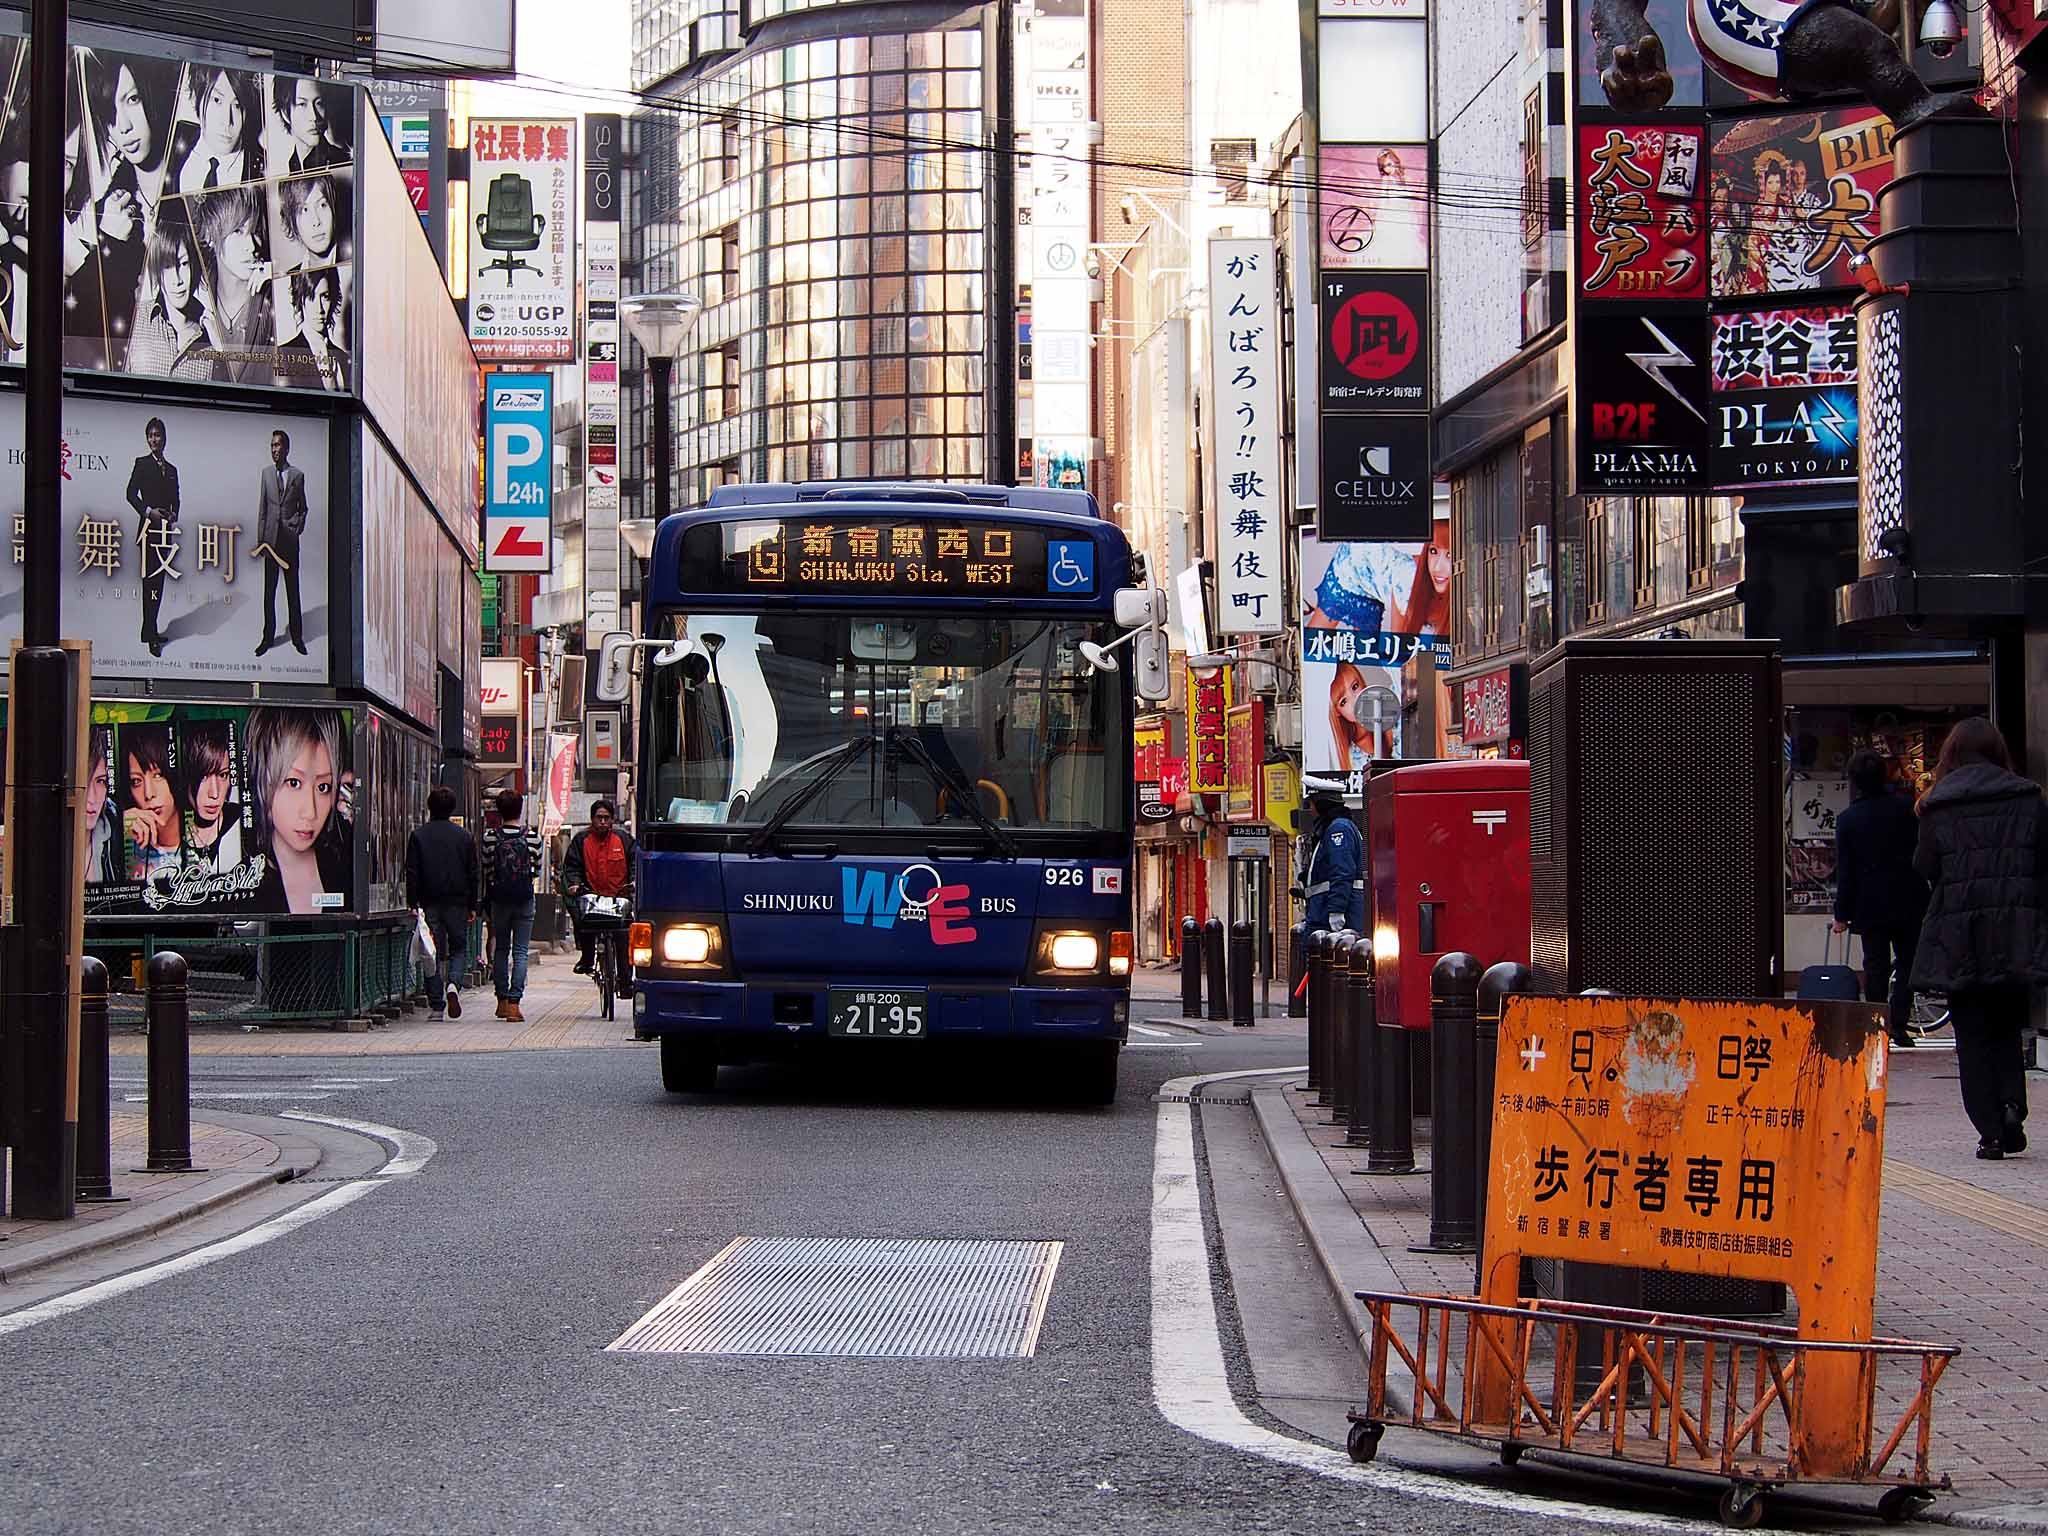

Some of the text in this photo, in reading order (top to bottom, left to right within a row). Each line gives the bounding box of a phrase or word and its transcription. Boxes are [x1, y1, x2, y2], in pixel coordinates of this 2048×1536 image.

[475, 125, 568, 161] 社長募集
[1664, 137, 1694, 191] 和風
[1583, 131, 1652, 291] 大江戸
[1328, 284, 1344, 297] 1F
[1617, 271, 1664, 291] B1F
[518, 306, 565, 321] UGP
[489, 326, 568, 336] 0120-5055-92
[472, 342, 569, 355] www.ugp.co.jp
[1717, 321, 1812, 380] 渋谷
[1329, 386, 1422, 398] 新宿ゴールデン街発祥
[1592, 403, 1656, 440] B2F
[75, 453, 109, 471] TEN
[493, 423, 544, 504] P
[509, 482, 544, 504] 24h
[1335, 480, 1415, 498] CELUX
[803, 526, 1013, 558] 新宿駅西口
[800, 561, 1015, 584] SHINJUKU Sta. WEST
[480, 728, 511, 739] Lady
[1045, 868, 1084, 886] 926
[743, 893, 834, 911] SHINJUKU
[980, 897, 1017, 914] BUS
[845, 1005, 923, 1035] 21-95
[1534, 1144, 1776, 1222] 歩行者専用
[1516, 1214, 1611, 1241] 新宿警察署
[1659, 1226, 1793, 1258] 歌舞伎町商店街振興組合
